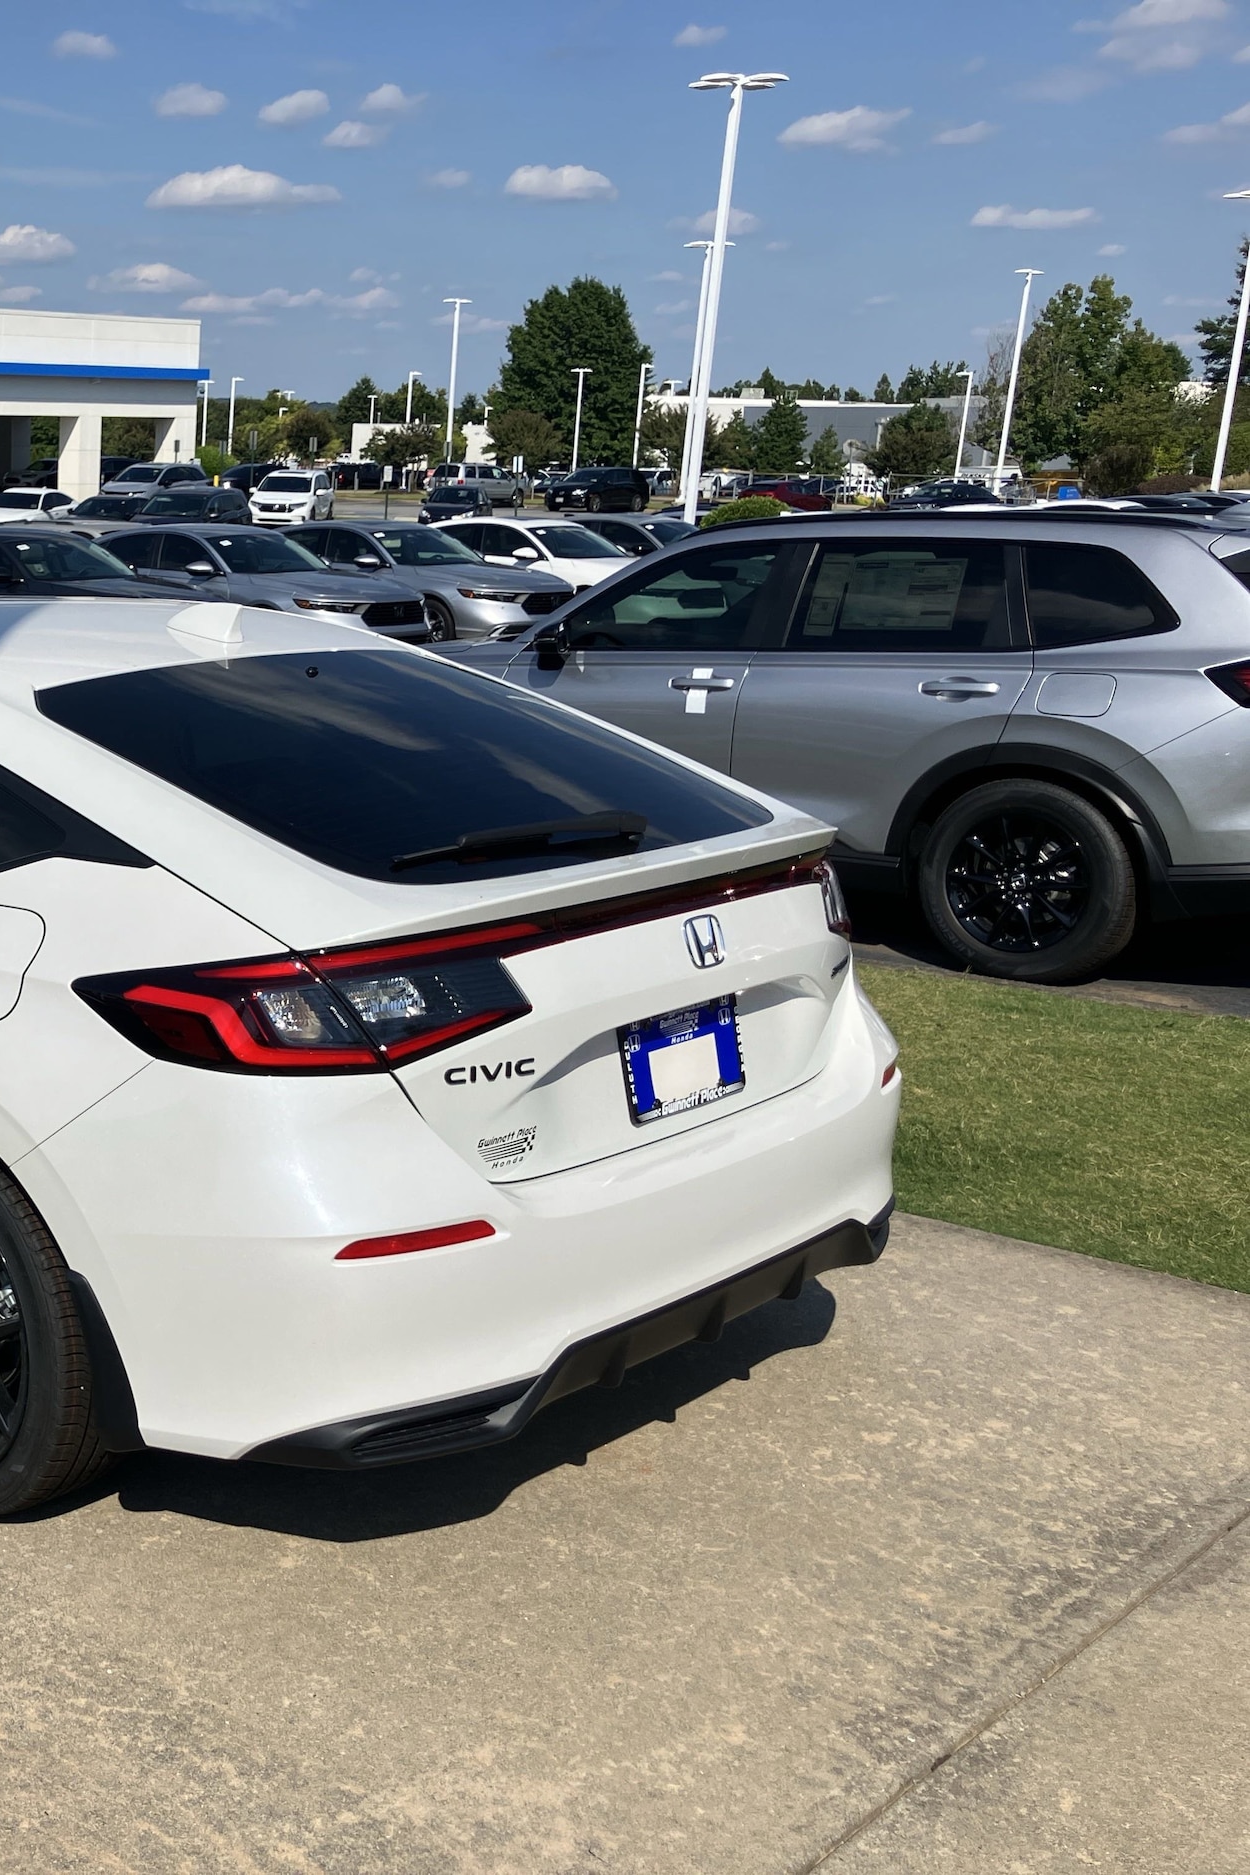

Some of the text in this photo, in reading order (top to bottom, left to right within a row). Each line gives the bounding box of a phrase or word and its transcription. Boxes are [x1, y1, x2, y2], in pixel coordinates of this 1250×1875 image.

[670, 1032, 694, 1045] Honda
[444, 1057, 536, 1086] CIVIC
[623, 1040, 639, 1105] DULUTH
[661, 1086, 724, 1115] Gwinnett Place
[477, 1125, 537, 1148] Gwinnett Place
[490, 1156, 524, 1169] Honda
